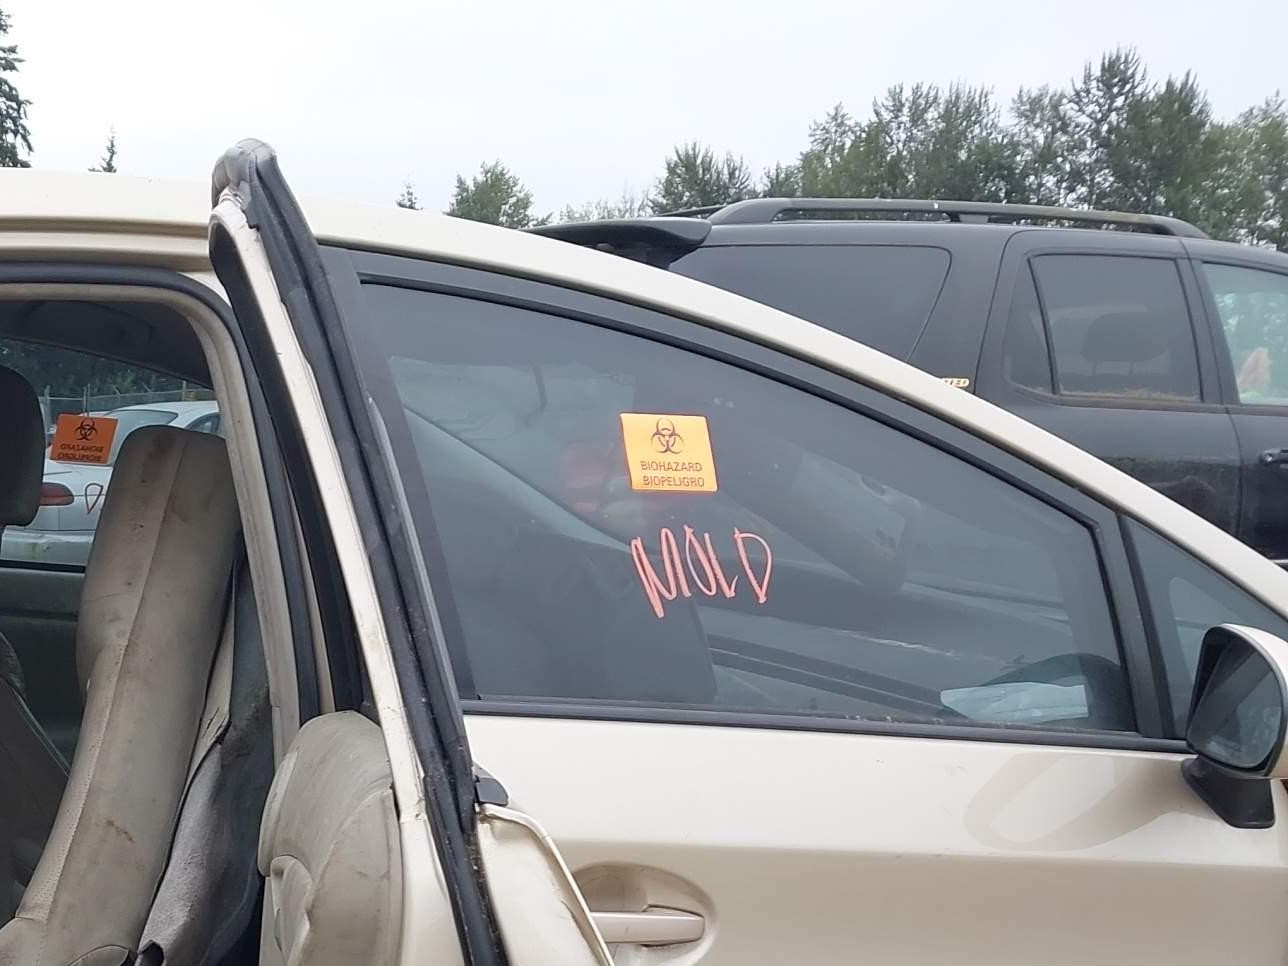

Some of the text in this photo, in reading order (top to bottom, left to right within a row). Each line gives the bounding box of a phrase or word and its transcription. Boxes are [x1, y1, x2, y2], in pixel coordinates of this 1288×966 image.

[640, 461, 702, 472] BIOHAZARD
[643, 475, 705, 487] BIOPELIGRO
[631, 525, 772, 618] MOLD
